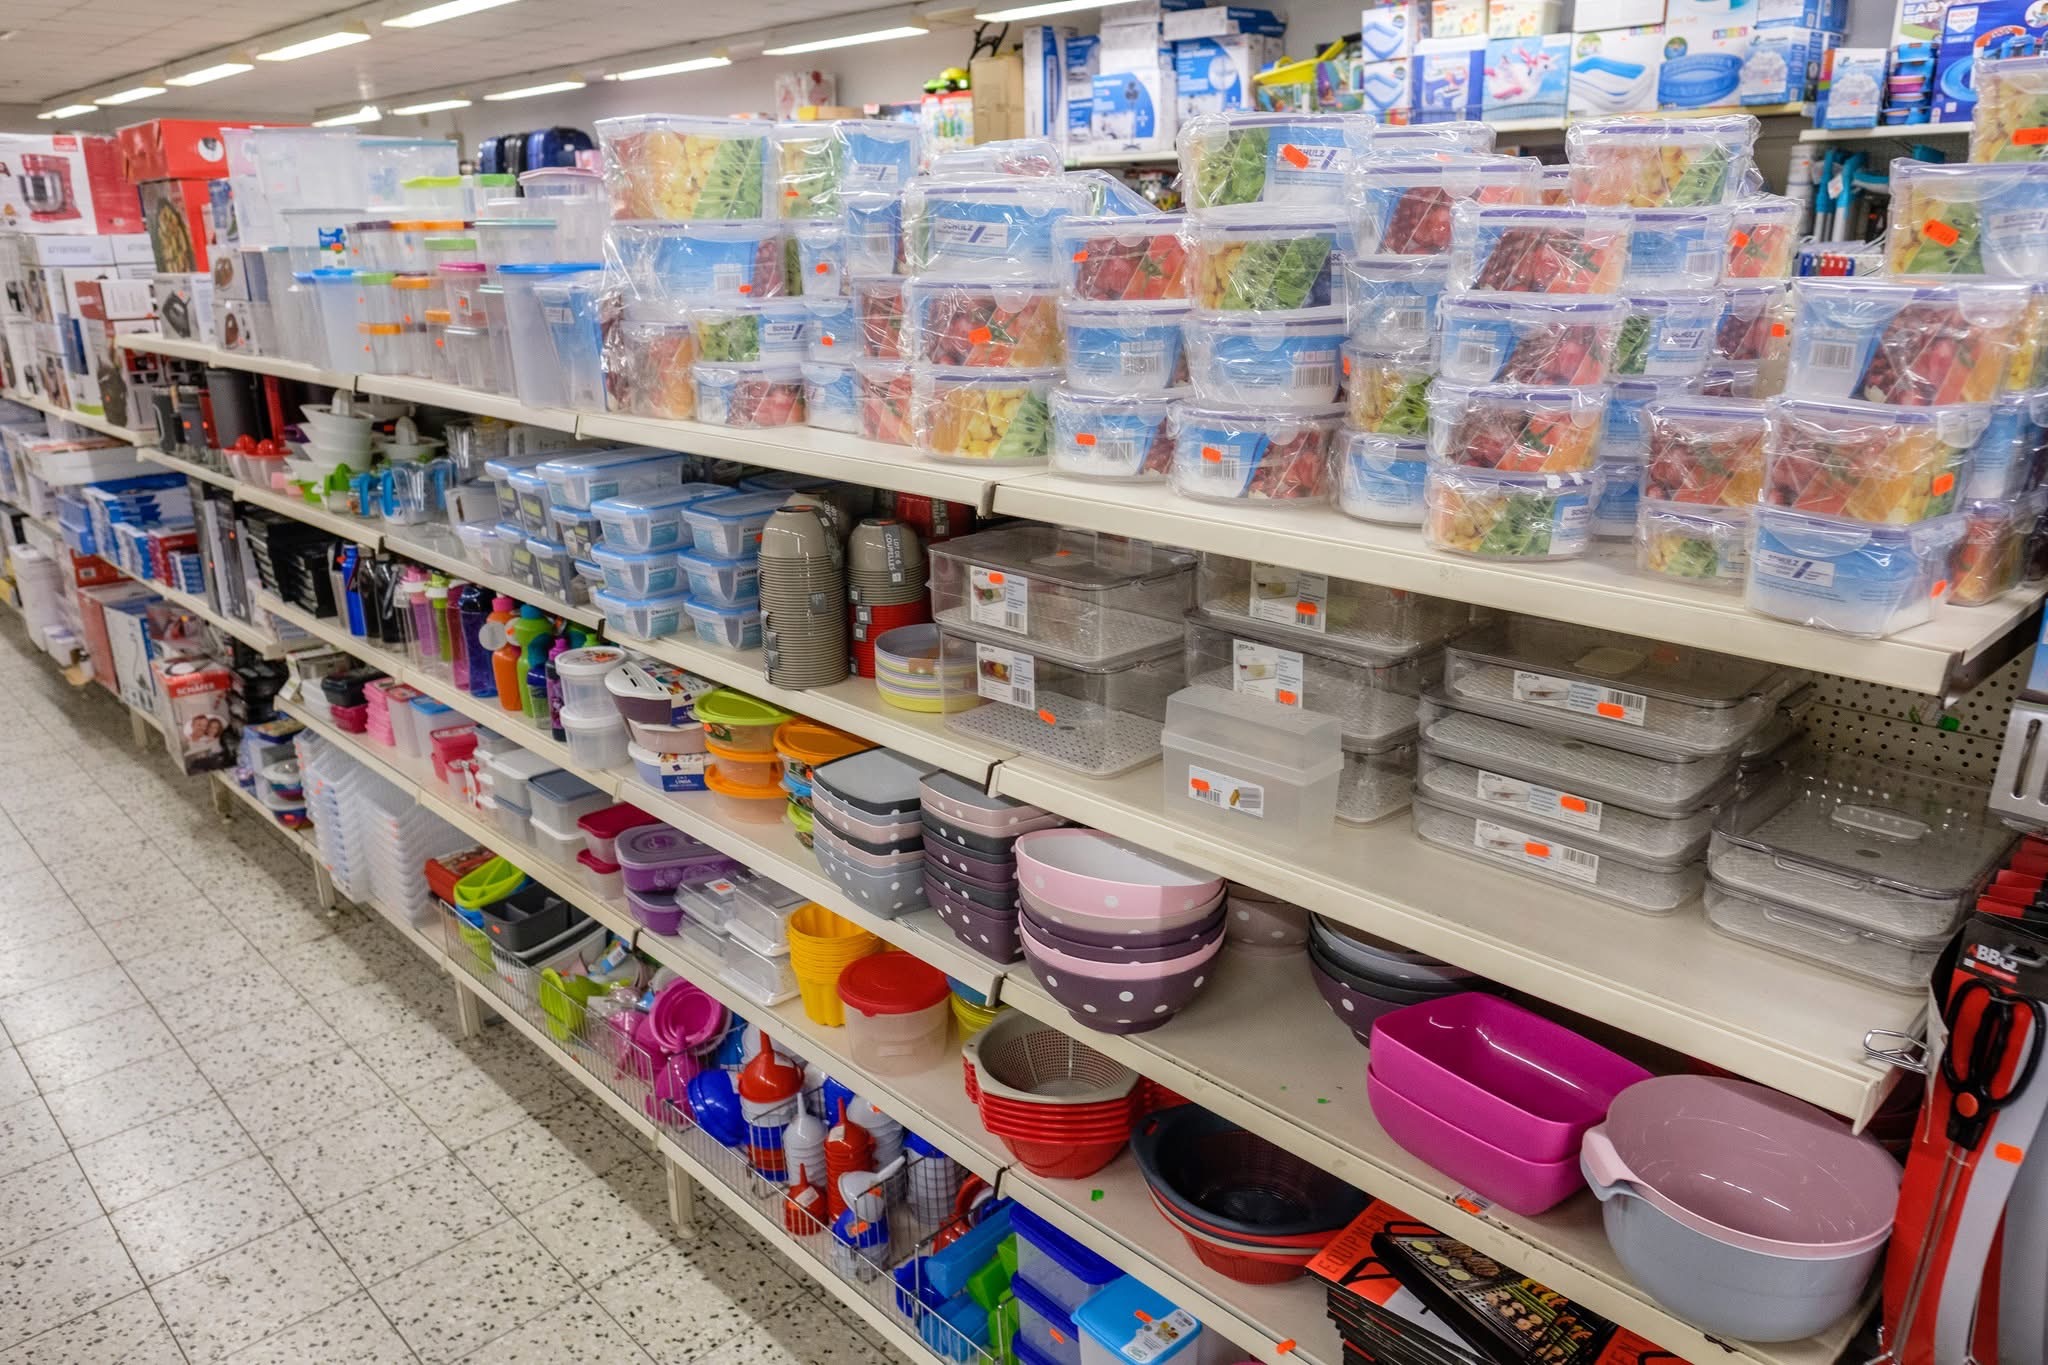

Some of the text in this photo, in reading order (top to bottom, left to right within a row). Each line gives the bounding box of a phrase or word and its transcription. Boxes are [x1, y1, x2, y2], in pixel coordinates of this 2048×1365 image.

[1904, 1, 1951, 15] EASY
[943, 222, 974, 231] SCHULZ
[885, 533, 896, 571] COUPELLES
[1976, 944, 2019, 974] BBQ
